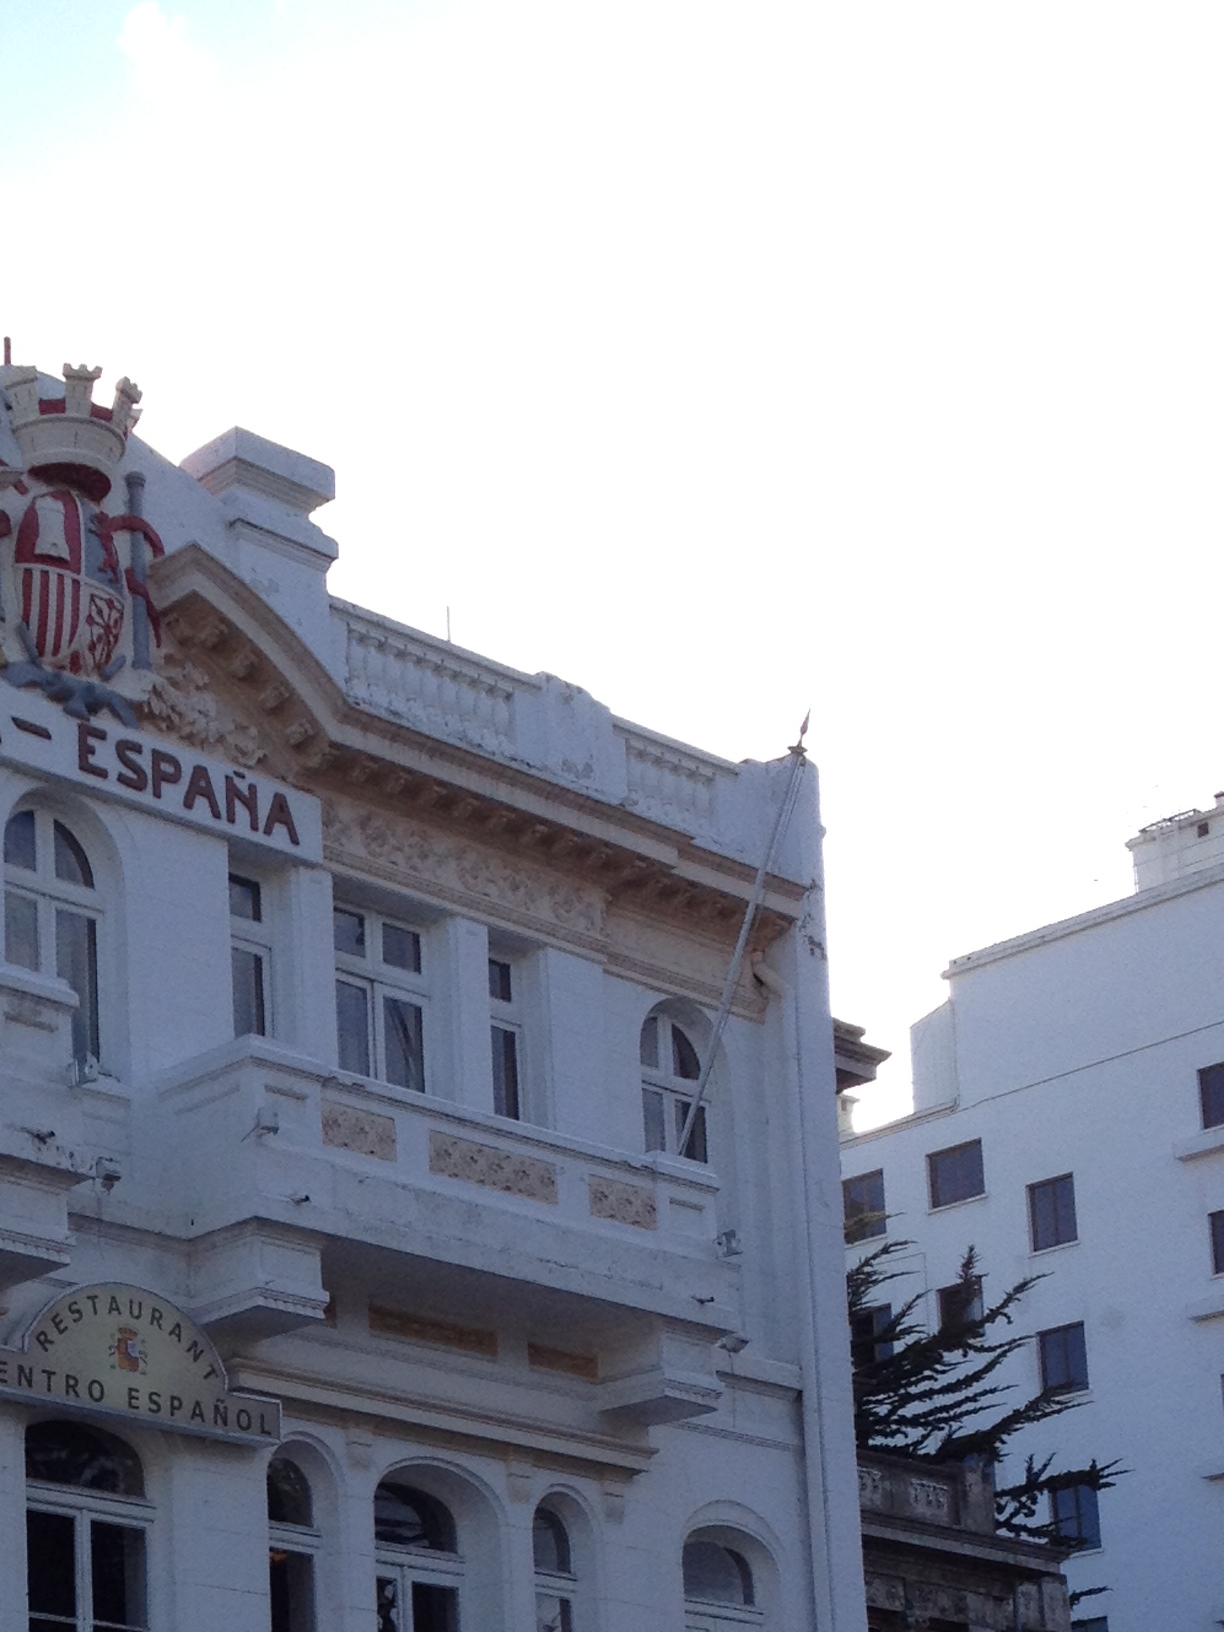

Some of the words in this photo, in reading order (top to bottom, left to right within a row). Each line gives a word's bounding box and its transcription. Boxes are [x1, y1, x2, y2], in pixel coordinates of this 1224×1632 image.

[78, 722, 299, 846] ESPAÑA
[35, 1295, 219, 1382] RESTAURANT
[127, 1387, 272, 1436] ESPAÑOL
